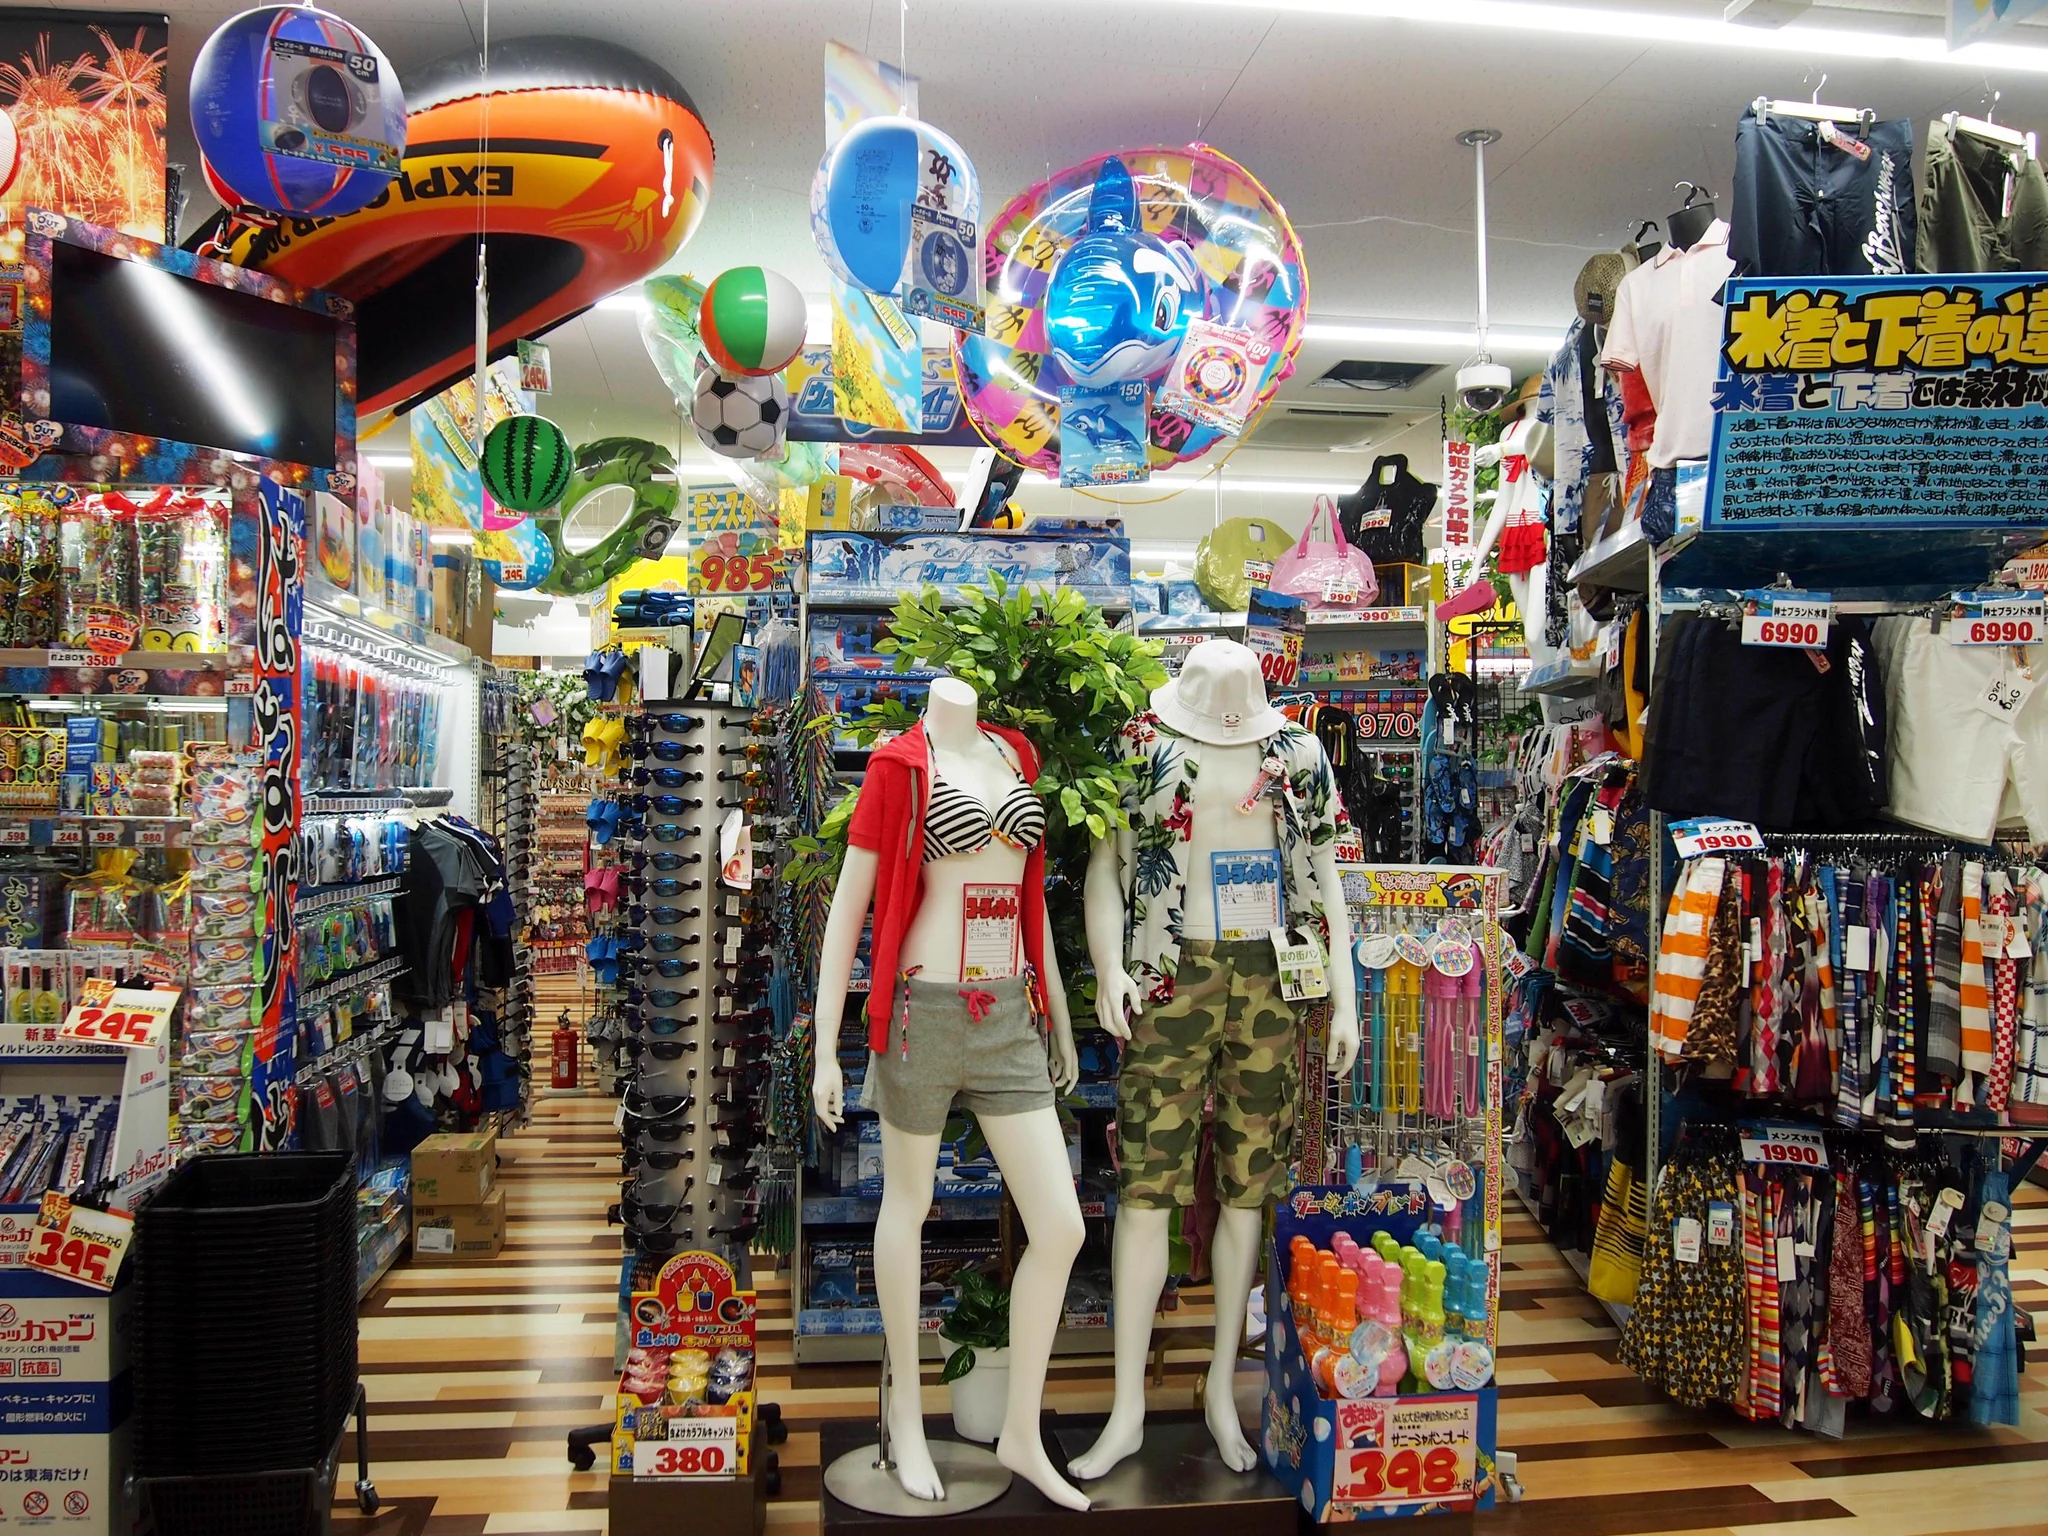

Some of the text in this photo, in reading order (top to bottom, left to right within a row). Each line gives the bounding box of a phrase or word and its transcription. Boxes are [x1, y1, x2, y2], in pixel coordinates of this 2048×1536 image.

[309, 46, 343, 59] Marina
[350, 55, 376, 77] 50 cm
[38, 215, 59, 228] OUT
[936, 211, 954, 224] Honu
[958, 224, 974, 237] 50
[1247, 340, 1270, 356] 100
[1119, 383, 1143, 396] 150
[33, 425, 55, 435] OUT
[1446, 440, 1471, 546] 防犯カメラ作動中
[701, 554, 775, 593] 985
[1330, 592, 1352, 602] 990
[1361, 611, 1389, 621] 990
[1773, 606, 1828, 618] 紳士ブランド水着
[1983, 606, 2042, 618] 紳士ブランド水着
[1760, 622, 1819, 644] 6990
[1970, 621, 2033, 642] 6990
[1179, 635, 1204, 644] 790
[86, 655, 117, 666] 3580
[1358, 713, 1415, 737] 970
[1694, 834, 1753, 851] 1990
[1215, 863, 1278, 885] コーディネート
[1378, 892, 1426, 905] ¥198
[966, 896, 1018, 919] コーディネート
[1222, 929, 1241, 938] TOTAL
[966, 967, 982, 975] TOTAL
[73, 1009, 154, 1043] 295
[1759, 1143, 1819, 1165] 1990
[116, 1151, 168, 1187] CRチャッカマン
[1714, 1228, 1726, 1237] M
[35, 1231, 111, 1282] 395
[1087, 1315, 1105, 1326] 298
[637, 1328, 681, 1347] 虫よけ
[21, 1360, 50, 1375] 抗菌
[669, 1426, 736, 1439] 虫よけカラフルキャンドル
[655, 1446, 725, 1474] 380
[1349, 1446, 1459, 1497] 398
